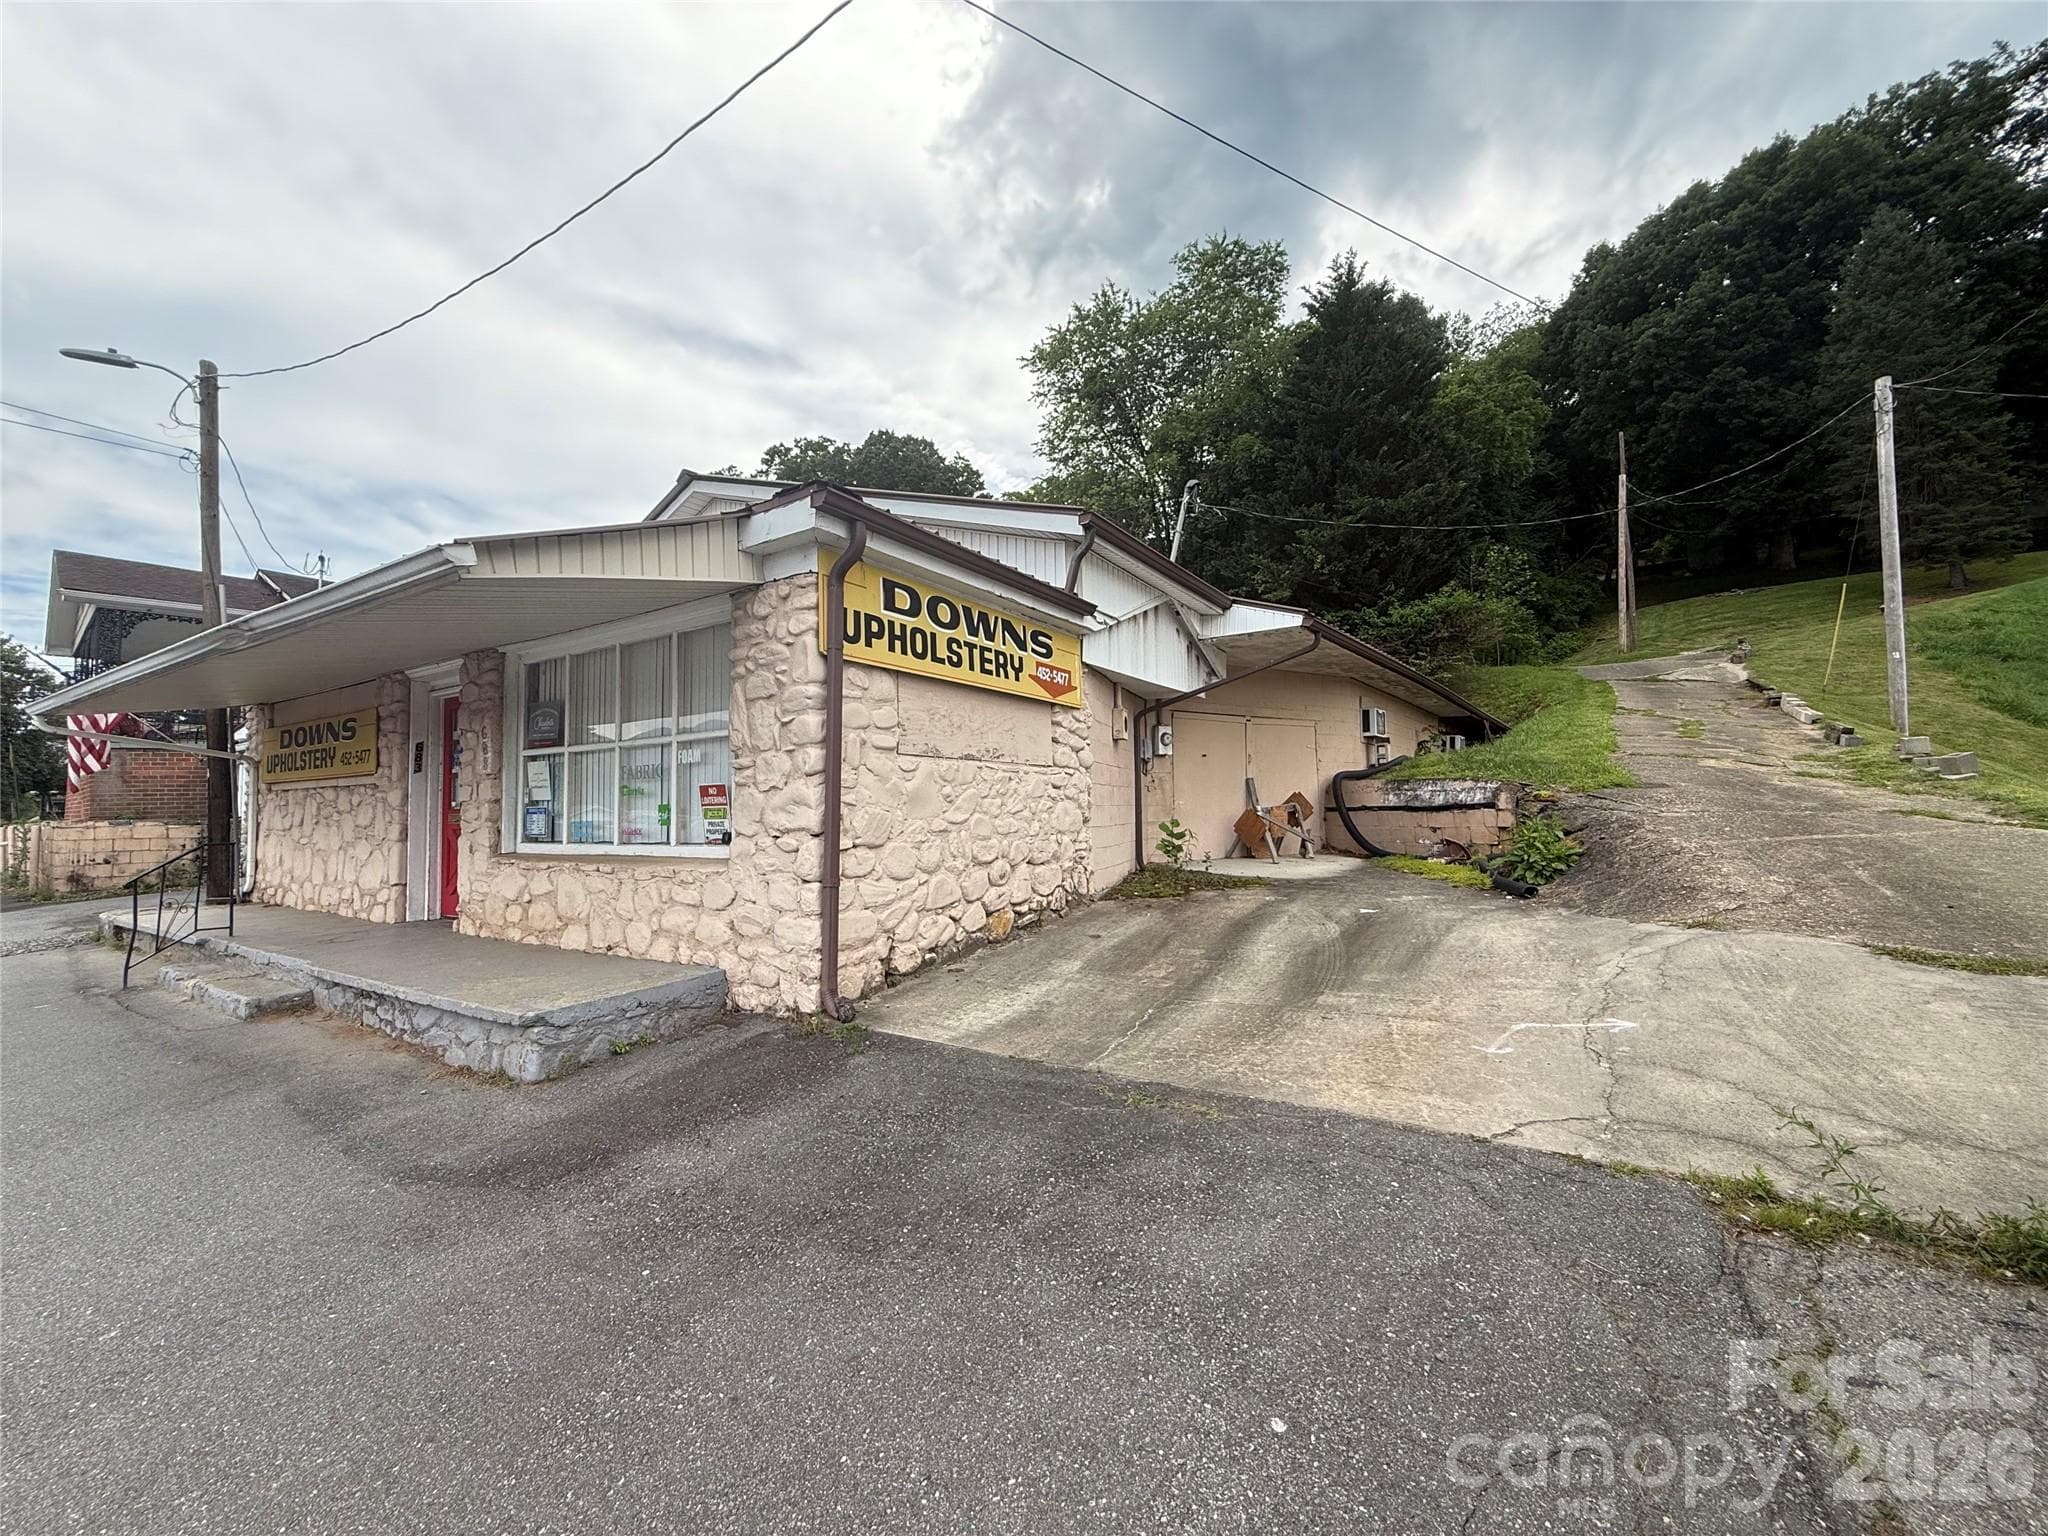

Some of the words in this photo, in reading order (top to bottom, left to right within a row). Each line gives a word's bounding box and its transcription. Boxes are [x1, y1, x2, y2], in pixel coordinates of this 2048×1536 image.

[881, 577, 1054, 661] DOWNS
[843, 607, 1024, 682] UPHOLSTERY
[1037, 666, 1069, 687] 452-5477
[279, 717, 357, 750] DOWNS
[266, 746, 337, 774] UPHOLSTERY
[340, 749, 371, 766] 452-5477
[678, 749, 700, 764] FOAM
[621, 763, 664, 780] FABRIC
[708, 786, 717, 795] NO
